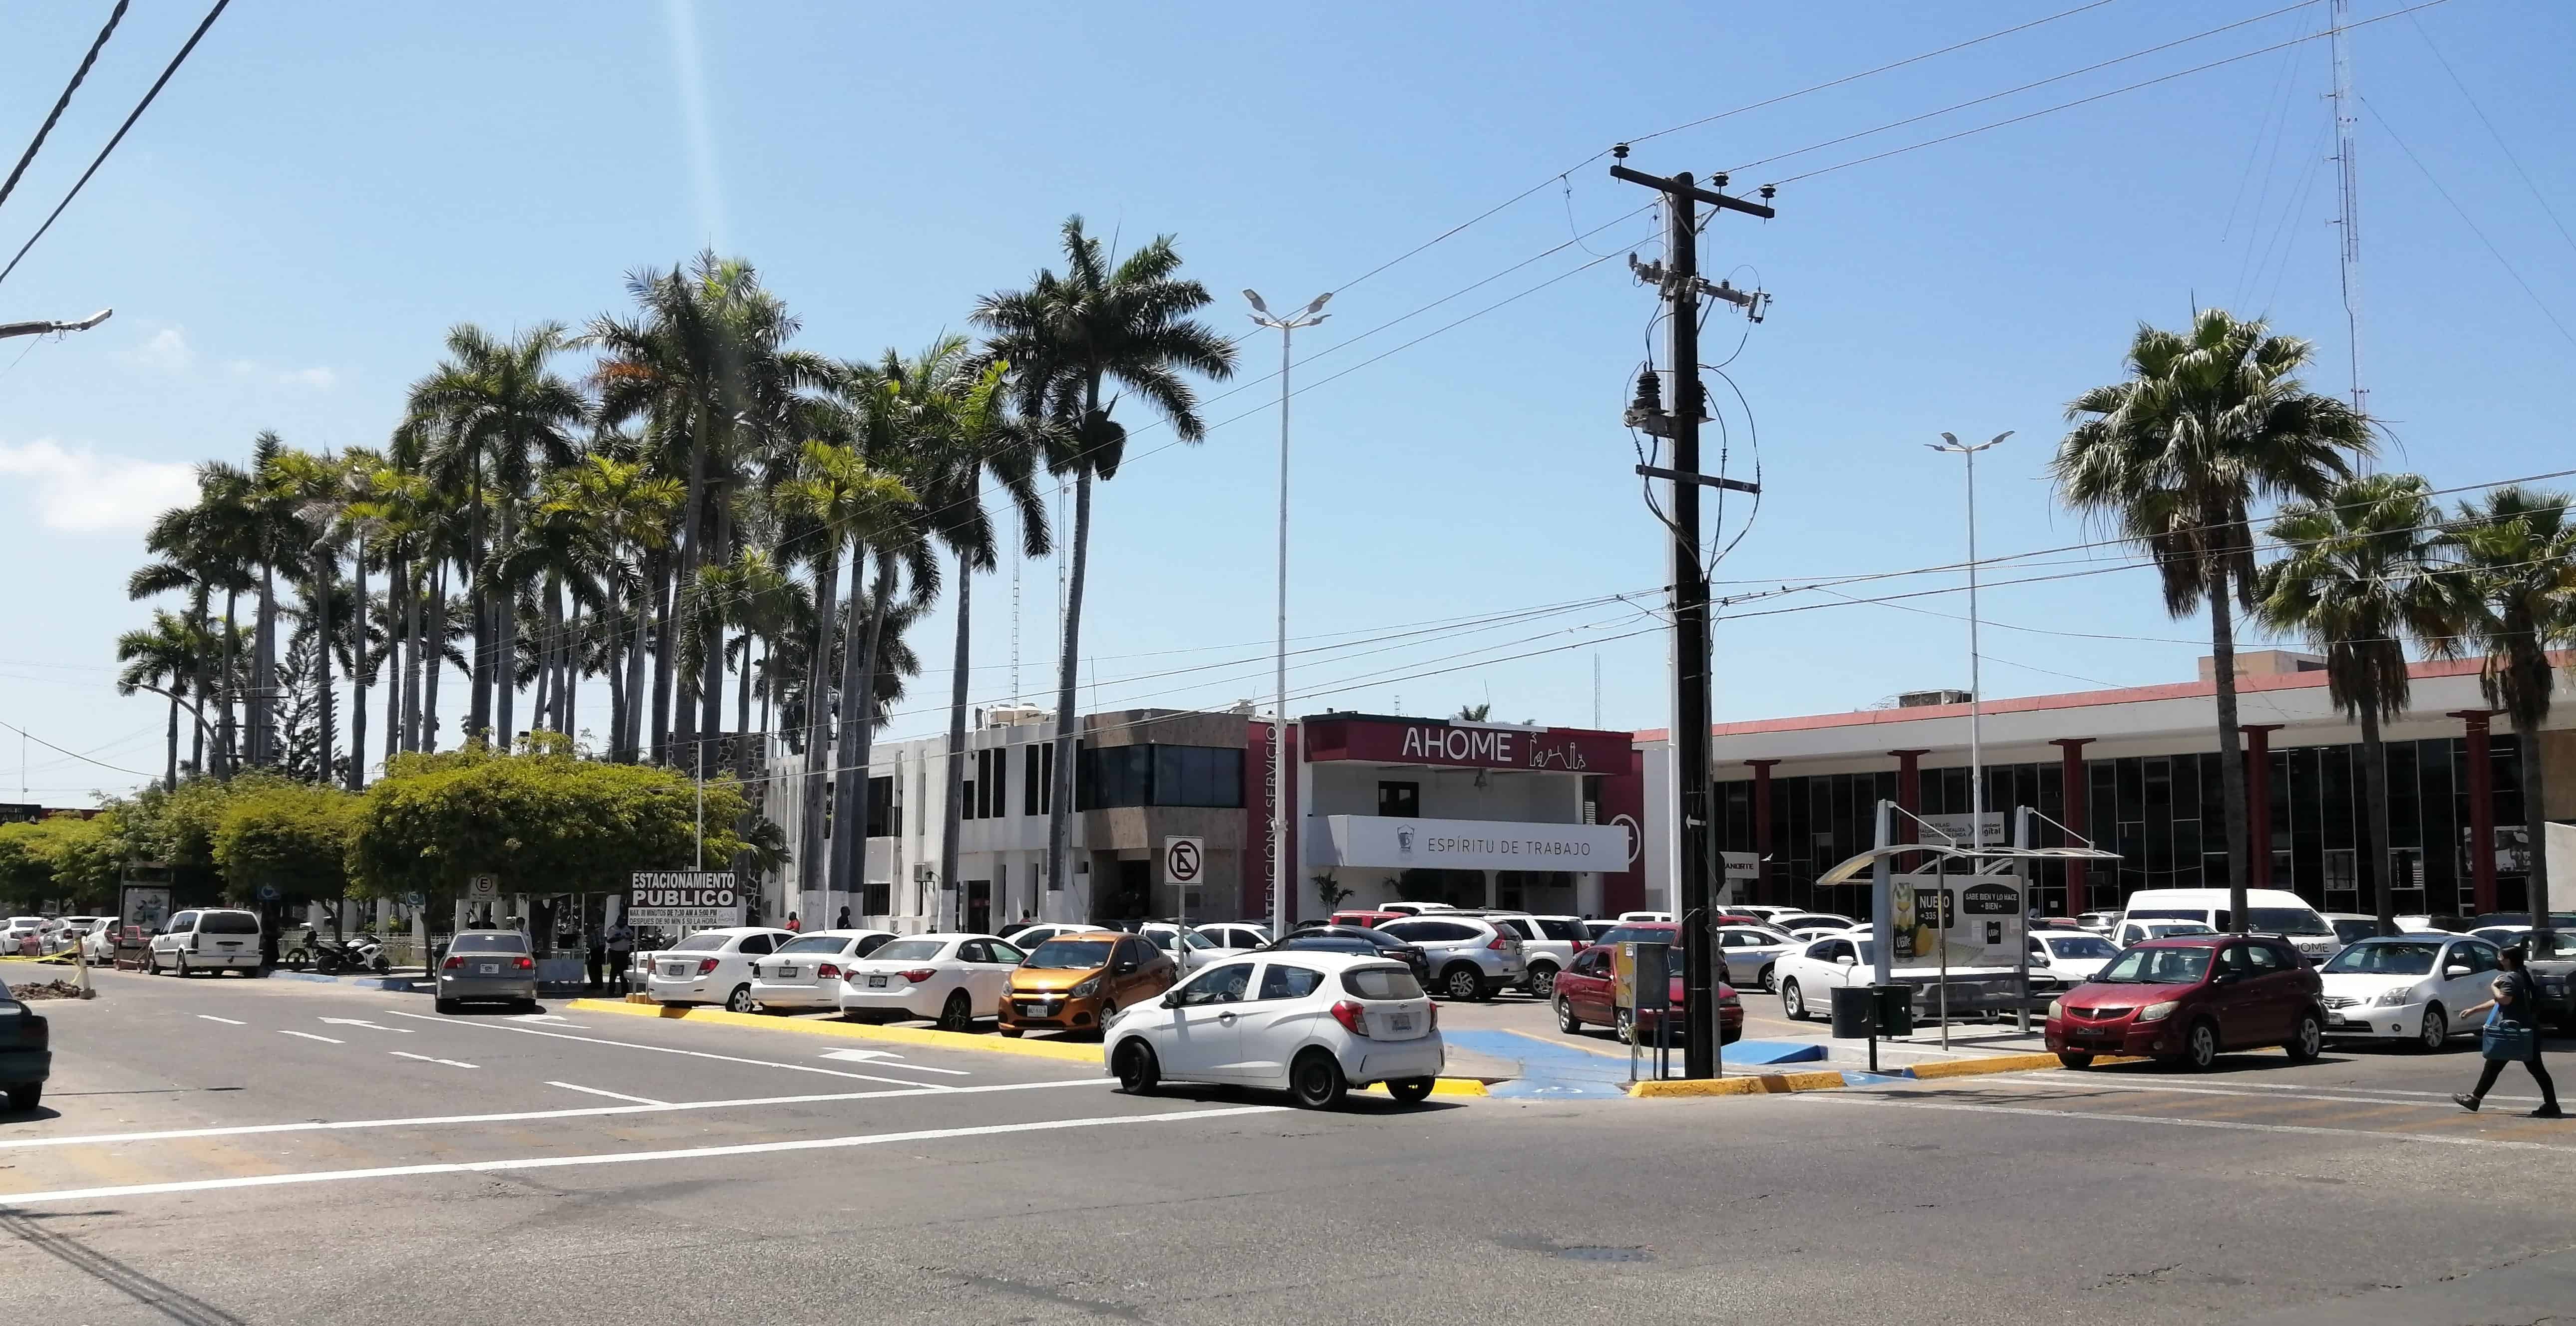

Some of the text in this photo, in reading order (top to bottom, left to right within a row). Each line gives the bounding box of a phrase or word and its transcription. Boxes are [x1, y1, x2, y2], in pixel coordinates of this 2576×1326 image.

[1402, 727, 1512, 762] AHOME
[1266, 726, 1276, 807] SERVICIO
[1982, 827, 2000, 836] igital
[1428, 835, 1590, 856] ESPÍRITU DE TRABAJO
[632, 873, 735, 888] ESTACIONAMIENTO
[1263, 830, 1274, 919] TENCIÓN
[633, 890, 733, 906] PUBLICO
[1920, 895, 1949, 908] NUEO
